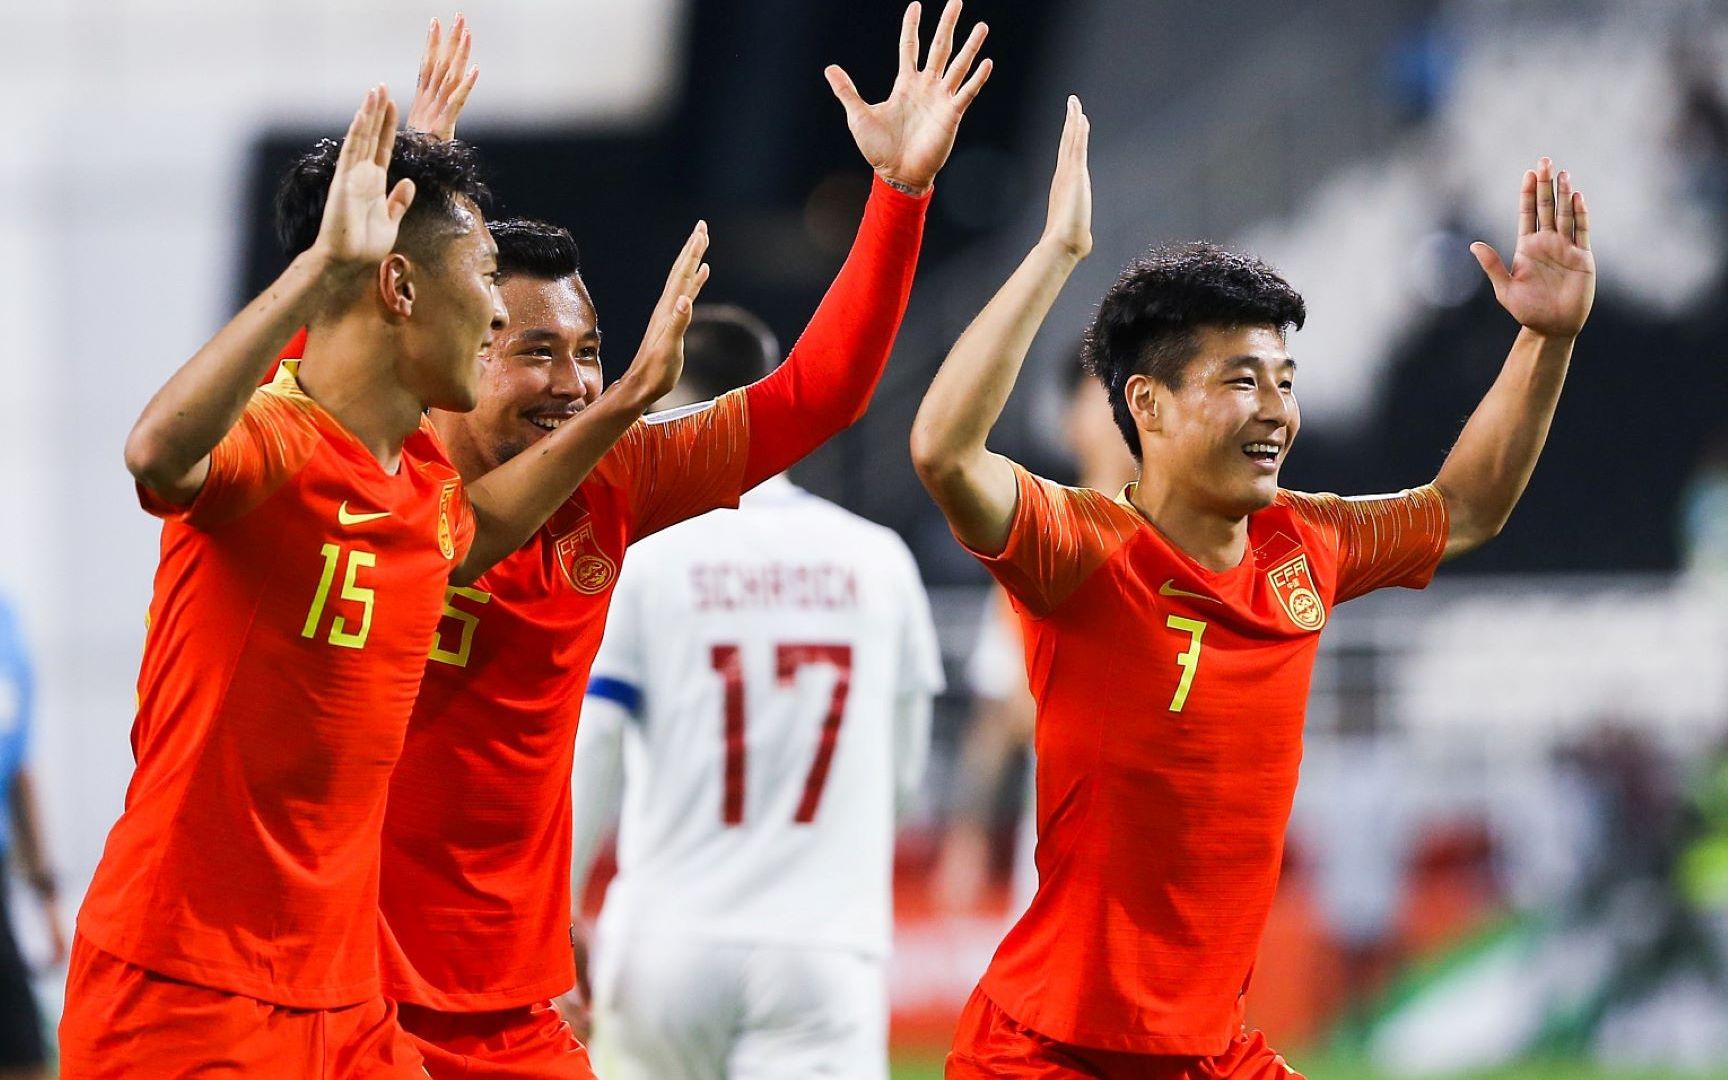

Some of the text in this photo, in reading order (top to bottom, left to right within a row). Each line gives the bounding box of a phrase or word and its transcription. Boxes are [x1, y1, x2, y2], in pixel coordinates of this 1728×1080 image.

[301, 543, 376, 649] 15
[1273, 561, 1305, 588] CFA
[428, 585, 492, 668] 5
[1167, 615, 1207, 712] 7
[709, 643, 854, 826] 17
